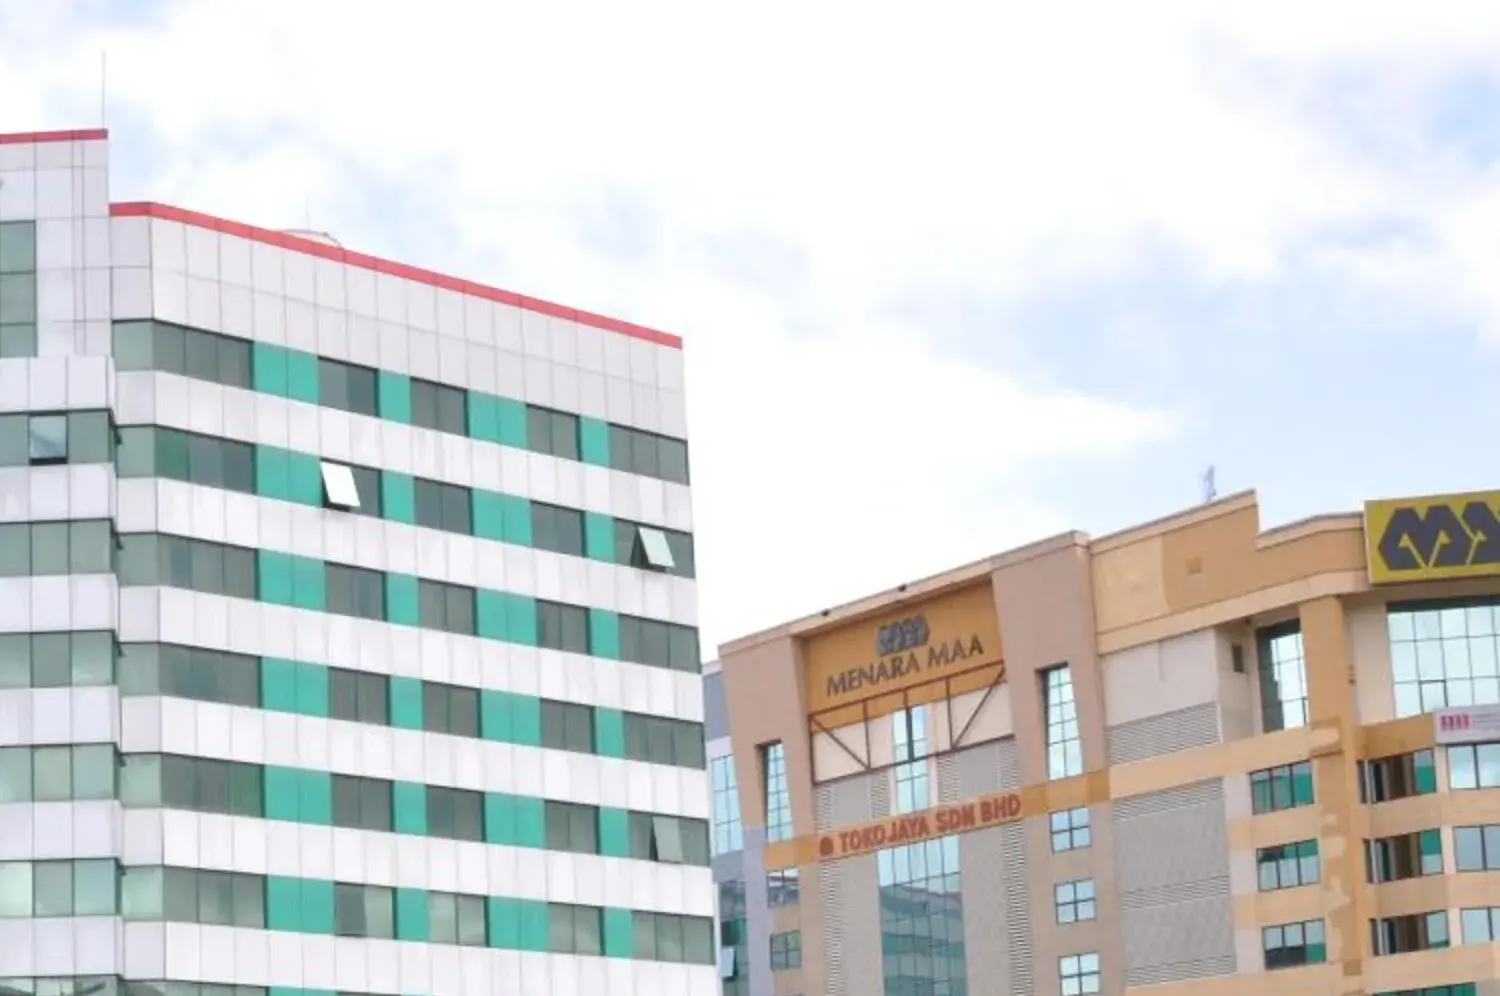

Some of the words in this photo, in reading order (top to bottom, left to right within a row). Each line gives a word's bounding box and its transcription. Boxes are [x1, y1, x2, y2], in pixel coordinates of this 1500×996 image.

[827, 652, 920, 697] MENARA
[928, 633, 985, 669] MAA
[936, 804, 975, 832] SDN
[981, 793, 1022, 823] BHD
